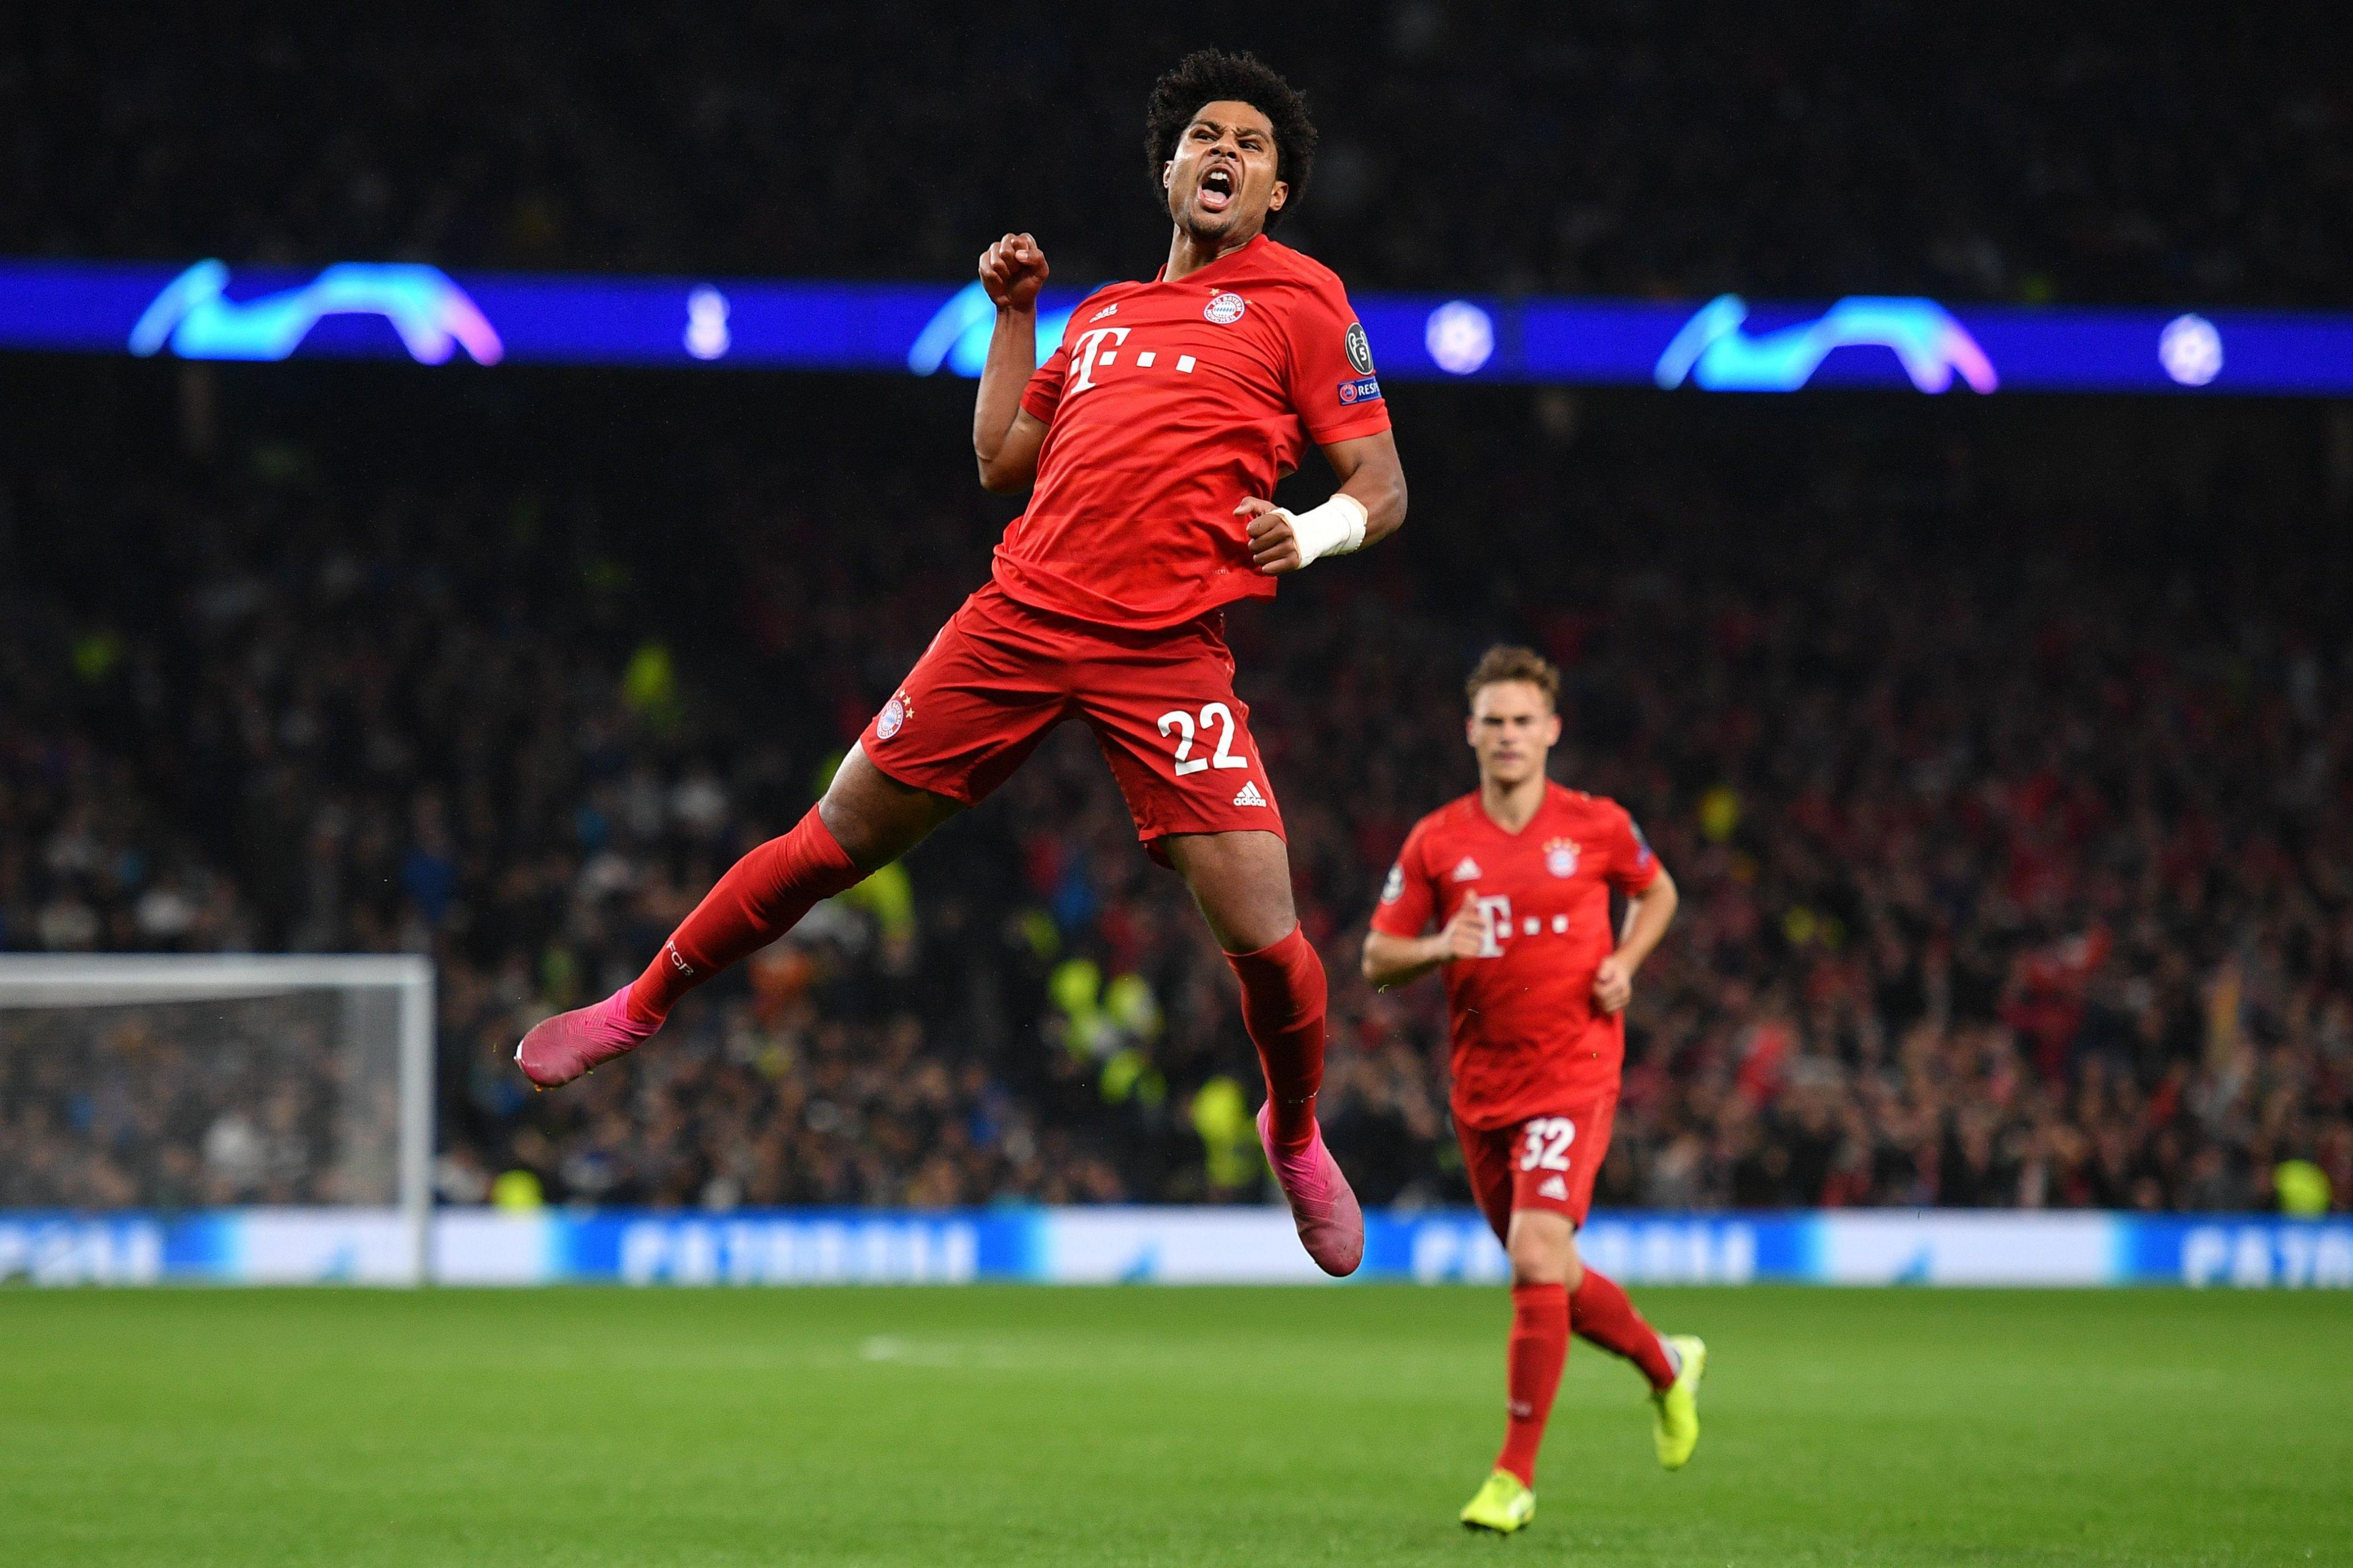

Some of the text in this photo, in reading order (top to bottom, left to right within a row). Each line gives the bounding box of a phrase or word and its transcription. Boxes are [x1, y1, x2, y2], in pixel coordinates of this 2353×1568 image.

[1359, 347, 1367, 361] 5
[1157, 702, 1248, 776] 22
[1233, 796, 1267, 808] adidas
[1519, 1117, 1576, 1172] 32
